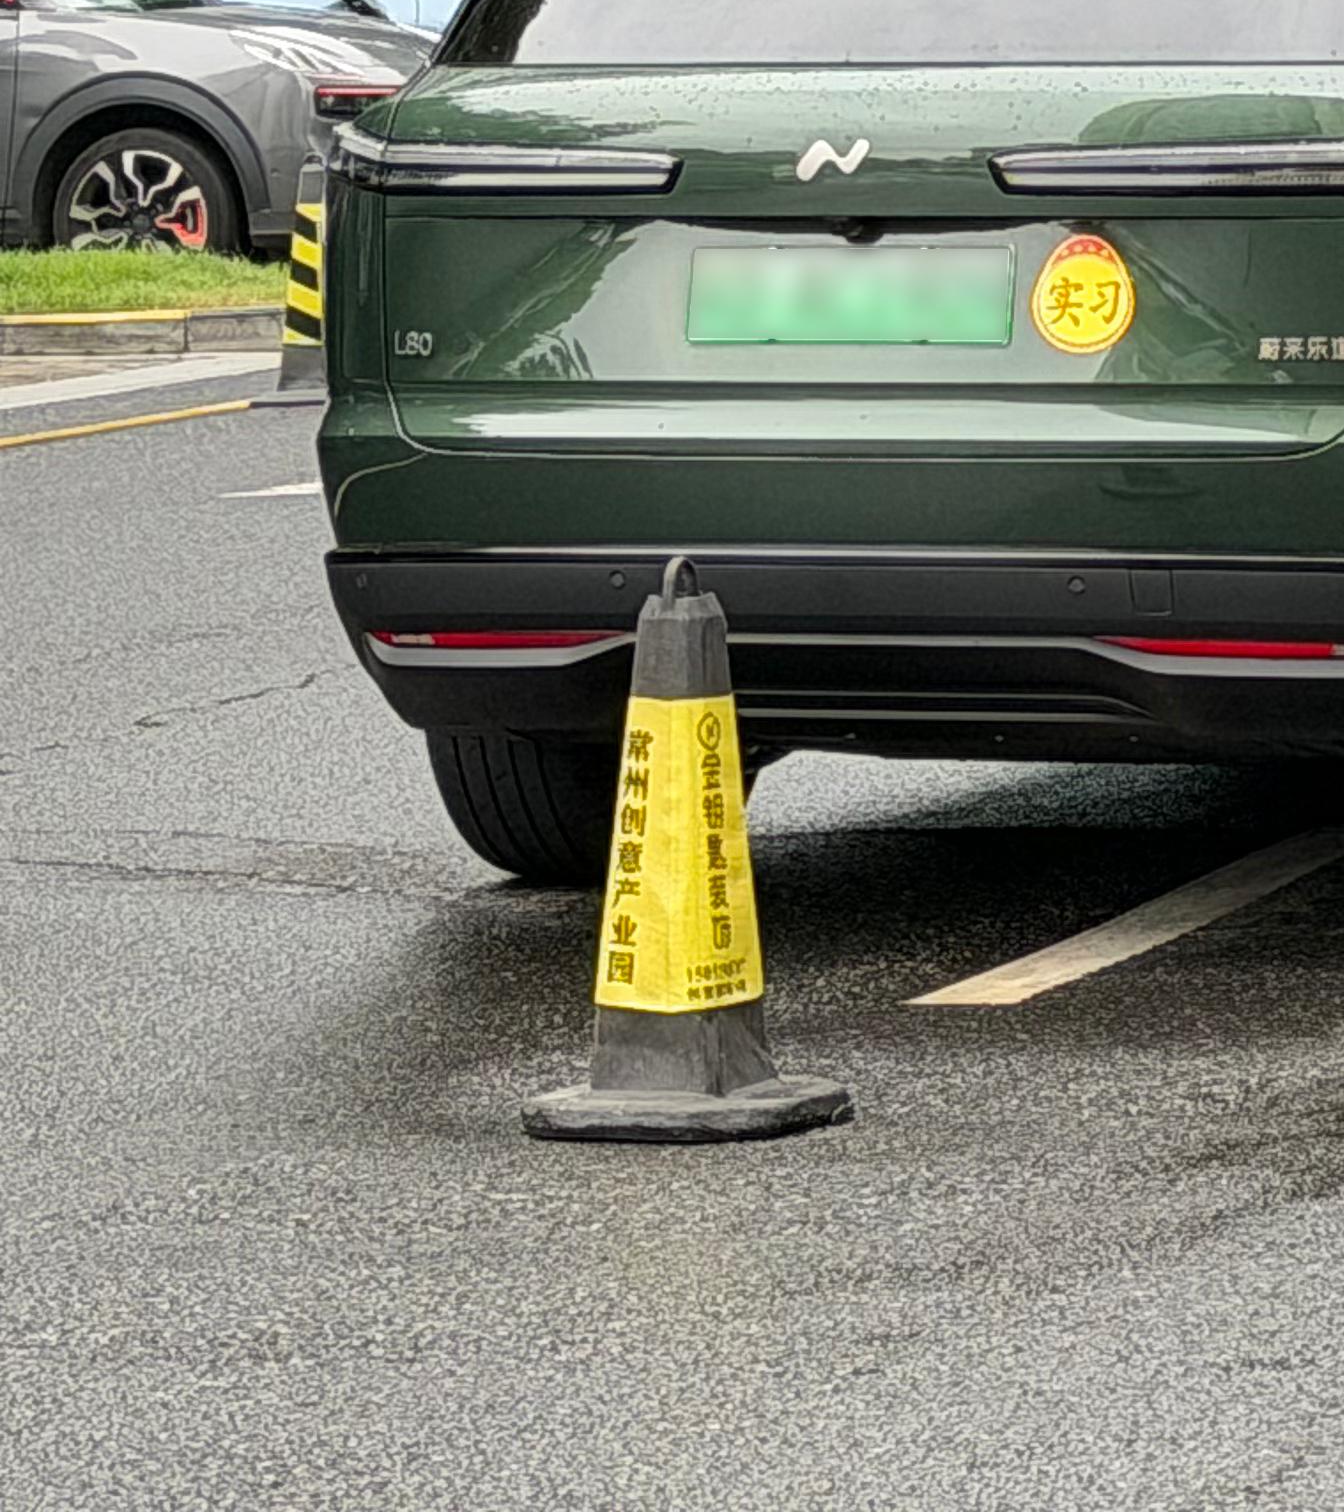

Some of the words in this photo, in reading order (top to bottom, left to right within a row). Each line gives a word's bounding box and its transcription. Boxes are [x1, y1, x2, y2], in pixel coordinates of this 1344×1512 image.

[1044, 276, 1121, 328] 实习
[607, 729, 654, 985] 常州创意产业园
